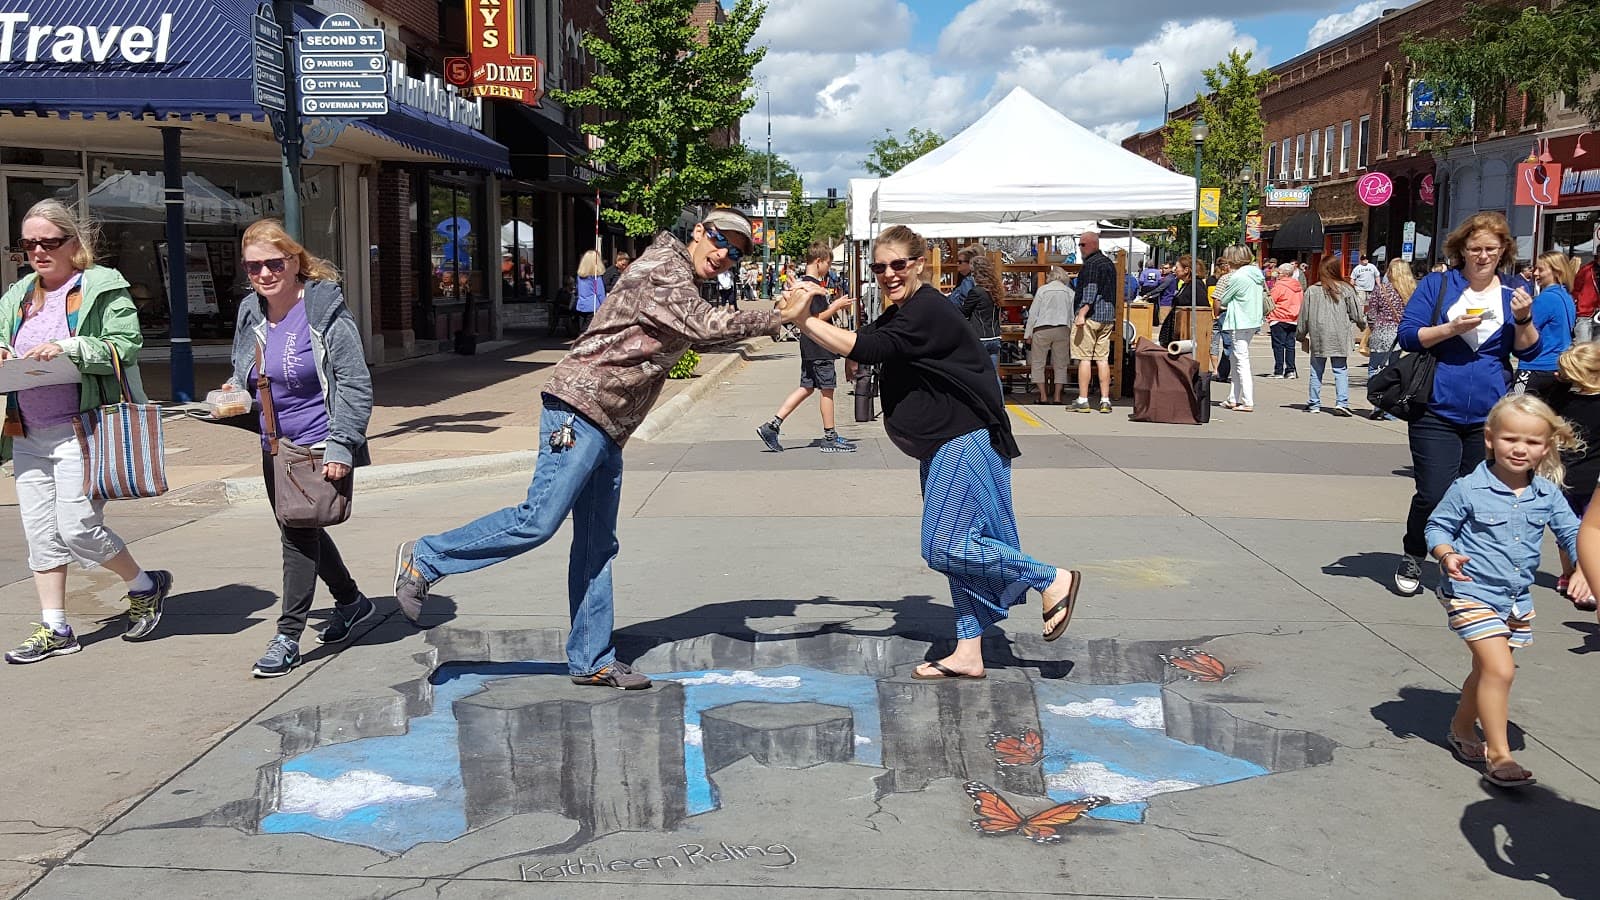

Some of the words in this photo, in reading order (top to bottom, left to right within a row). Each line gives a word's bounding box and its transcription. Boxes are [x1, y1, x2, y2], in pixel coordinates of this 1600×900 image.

[0, 12, 173, 63] Travel
[306, 36, 356, 46] SECOND
[359, 36, 377, 45] ST.
[452, 63, 466, 79] 5
[473, 65, 486, 78] and
[486, 63, 533, 82] DIME
[391, 60, 448, 118] Humble
[447, 84, 482, 130] Travel
[459, 84, 524, 100] TAVERN
[519, 854, 682, 882] Kathleen
